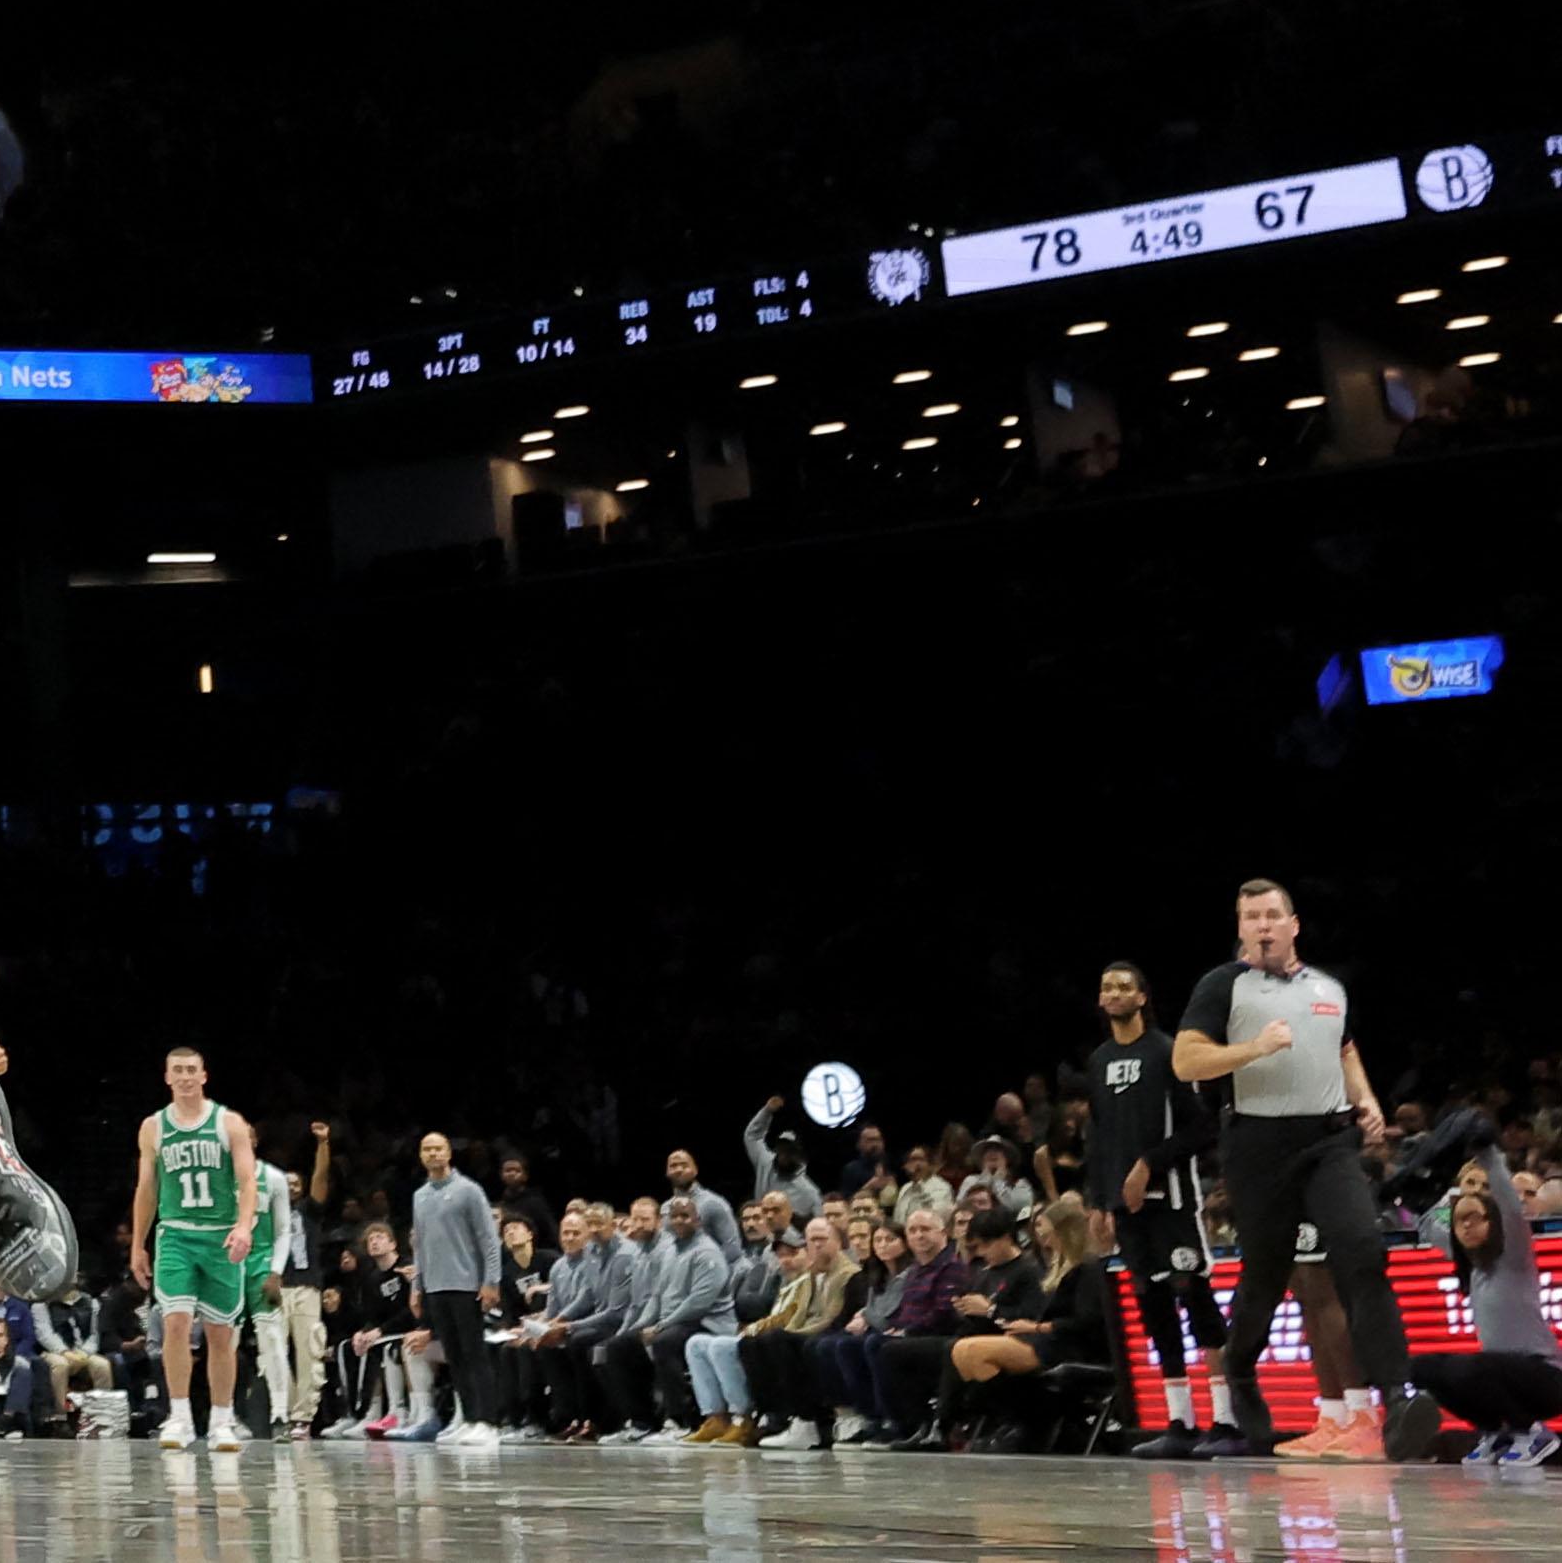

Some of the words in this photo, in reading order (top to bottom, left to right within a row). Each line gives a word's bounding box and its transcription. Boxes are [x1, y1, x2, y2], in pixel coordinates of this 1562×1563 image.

[1021, 227, 1082, 272] 78
[1131, 220, 1203, 255] 4:49
[1255, 184, 1315, 233] 67
[796, 270, 809, 289] 4
[687, 288, 715, 308] AST
[799, 299, 812, 318] 4
[533, 317, 550, 335] FT
[694, 312, 717, 333] 19
[625, 324, 648, 345] 34
[12, 365, 72, 389] Nets
[1433, 662, 1475, 687] WISE
[162, 1139, 222, 1174] BOSTON
[179, 1171, 214, 1208] 11
